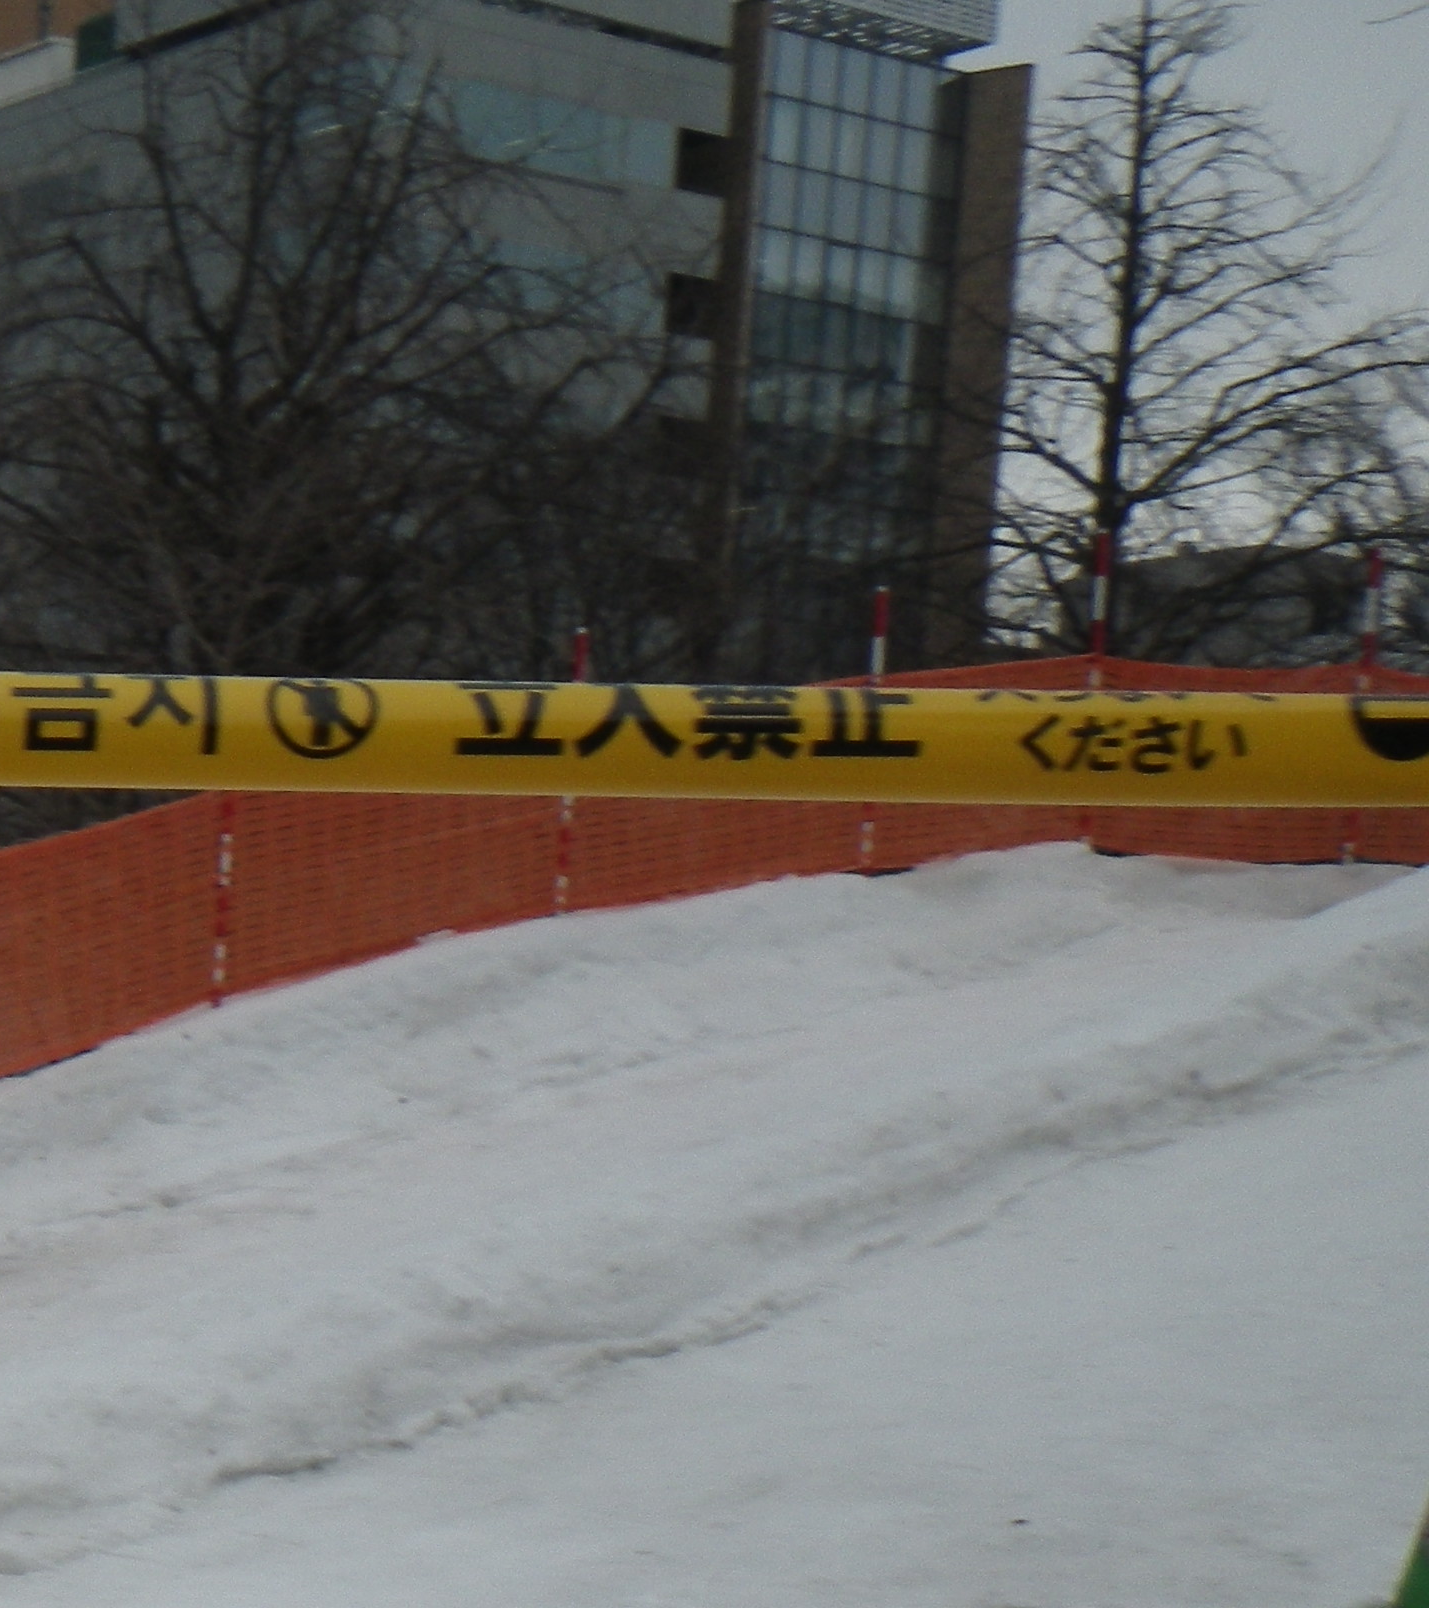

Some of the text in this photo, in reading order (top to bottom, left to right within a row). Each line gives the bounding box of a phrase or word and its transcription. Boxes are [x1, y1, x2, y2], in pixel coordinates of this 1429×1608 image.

[454, 682, 923, 760] 立入禁止
[1019, 715, 1249, 773] ください
